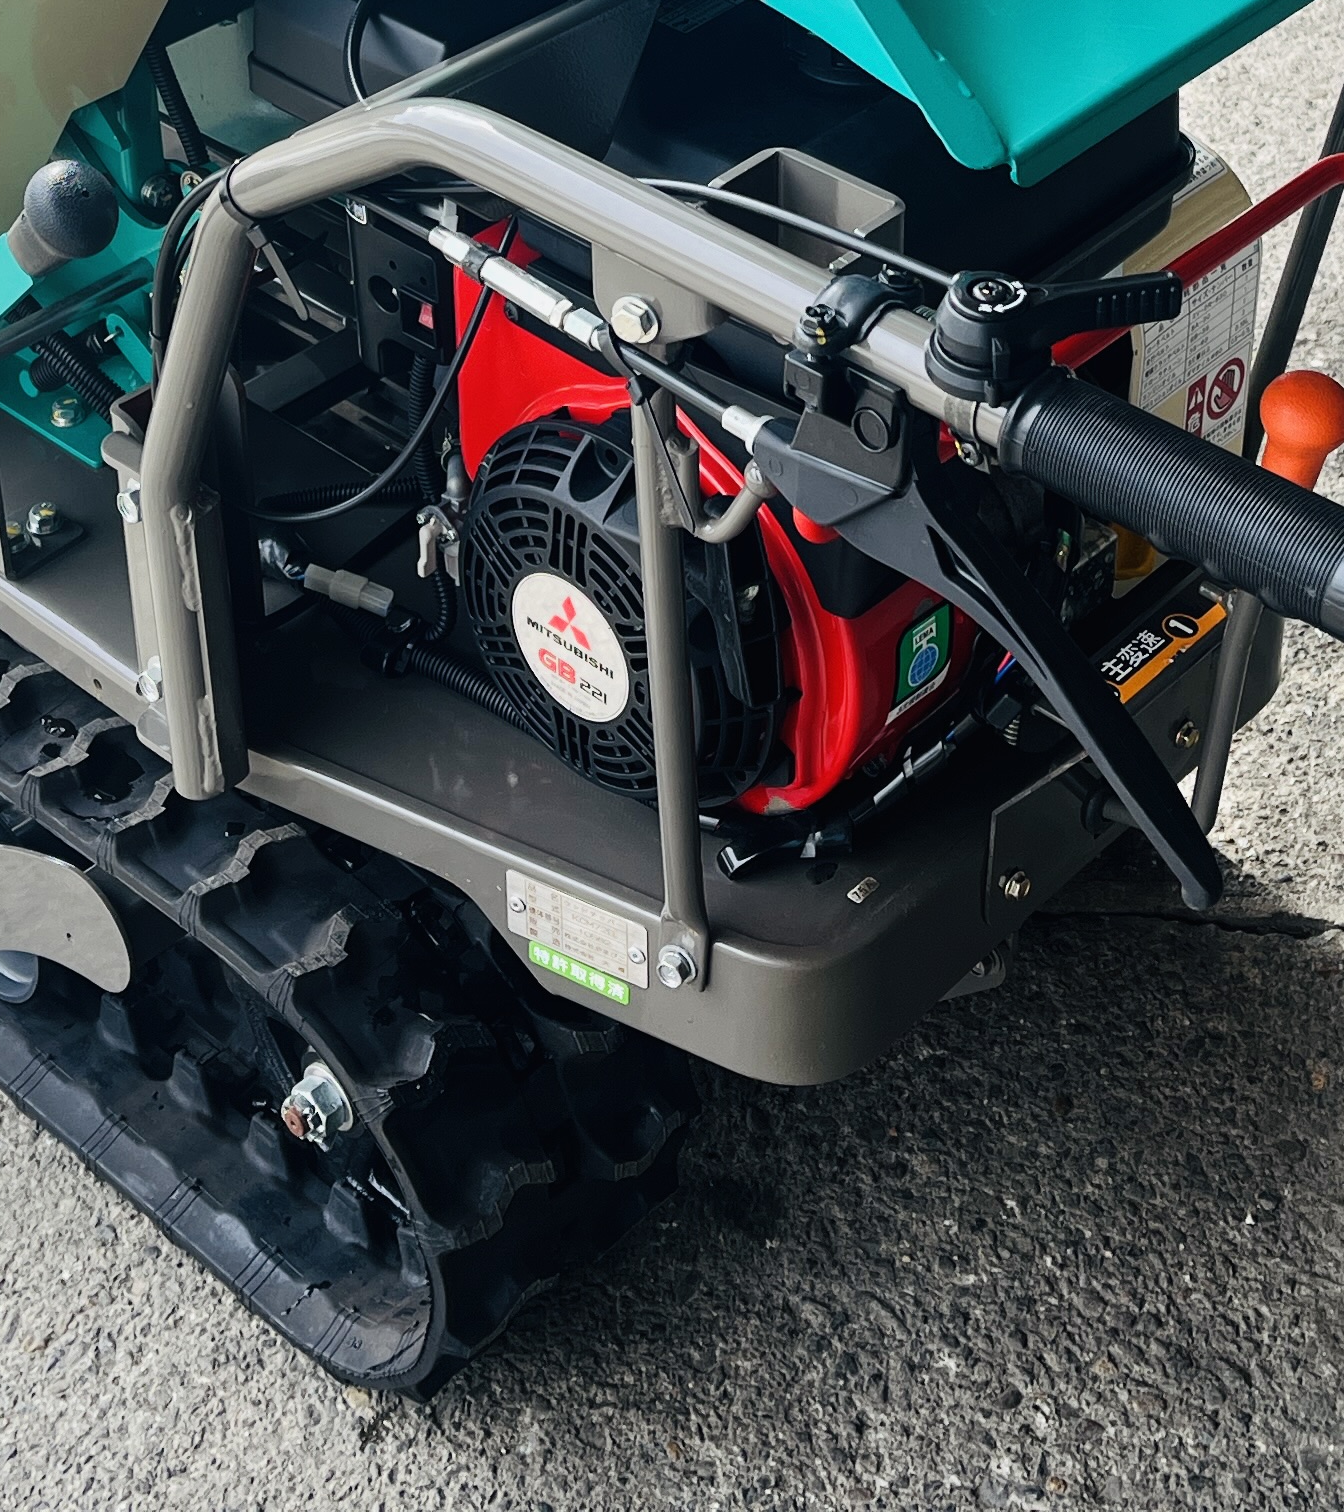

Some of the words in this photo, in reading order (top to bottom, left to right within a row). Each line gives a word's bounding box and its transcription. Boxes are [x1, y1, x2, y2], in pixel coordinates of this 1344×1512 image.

[527, 616, 614, 679] MITSUBISHI
[1101, 630, 1165, 681] 主変速
[1169, 619, 1193, 634] 1
